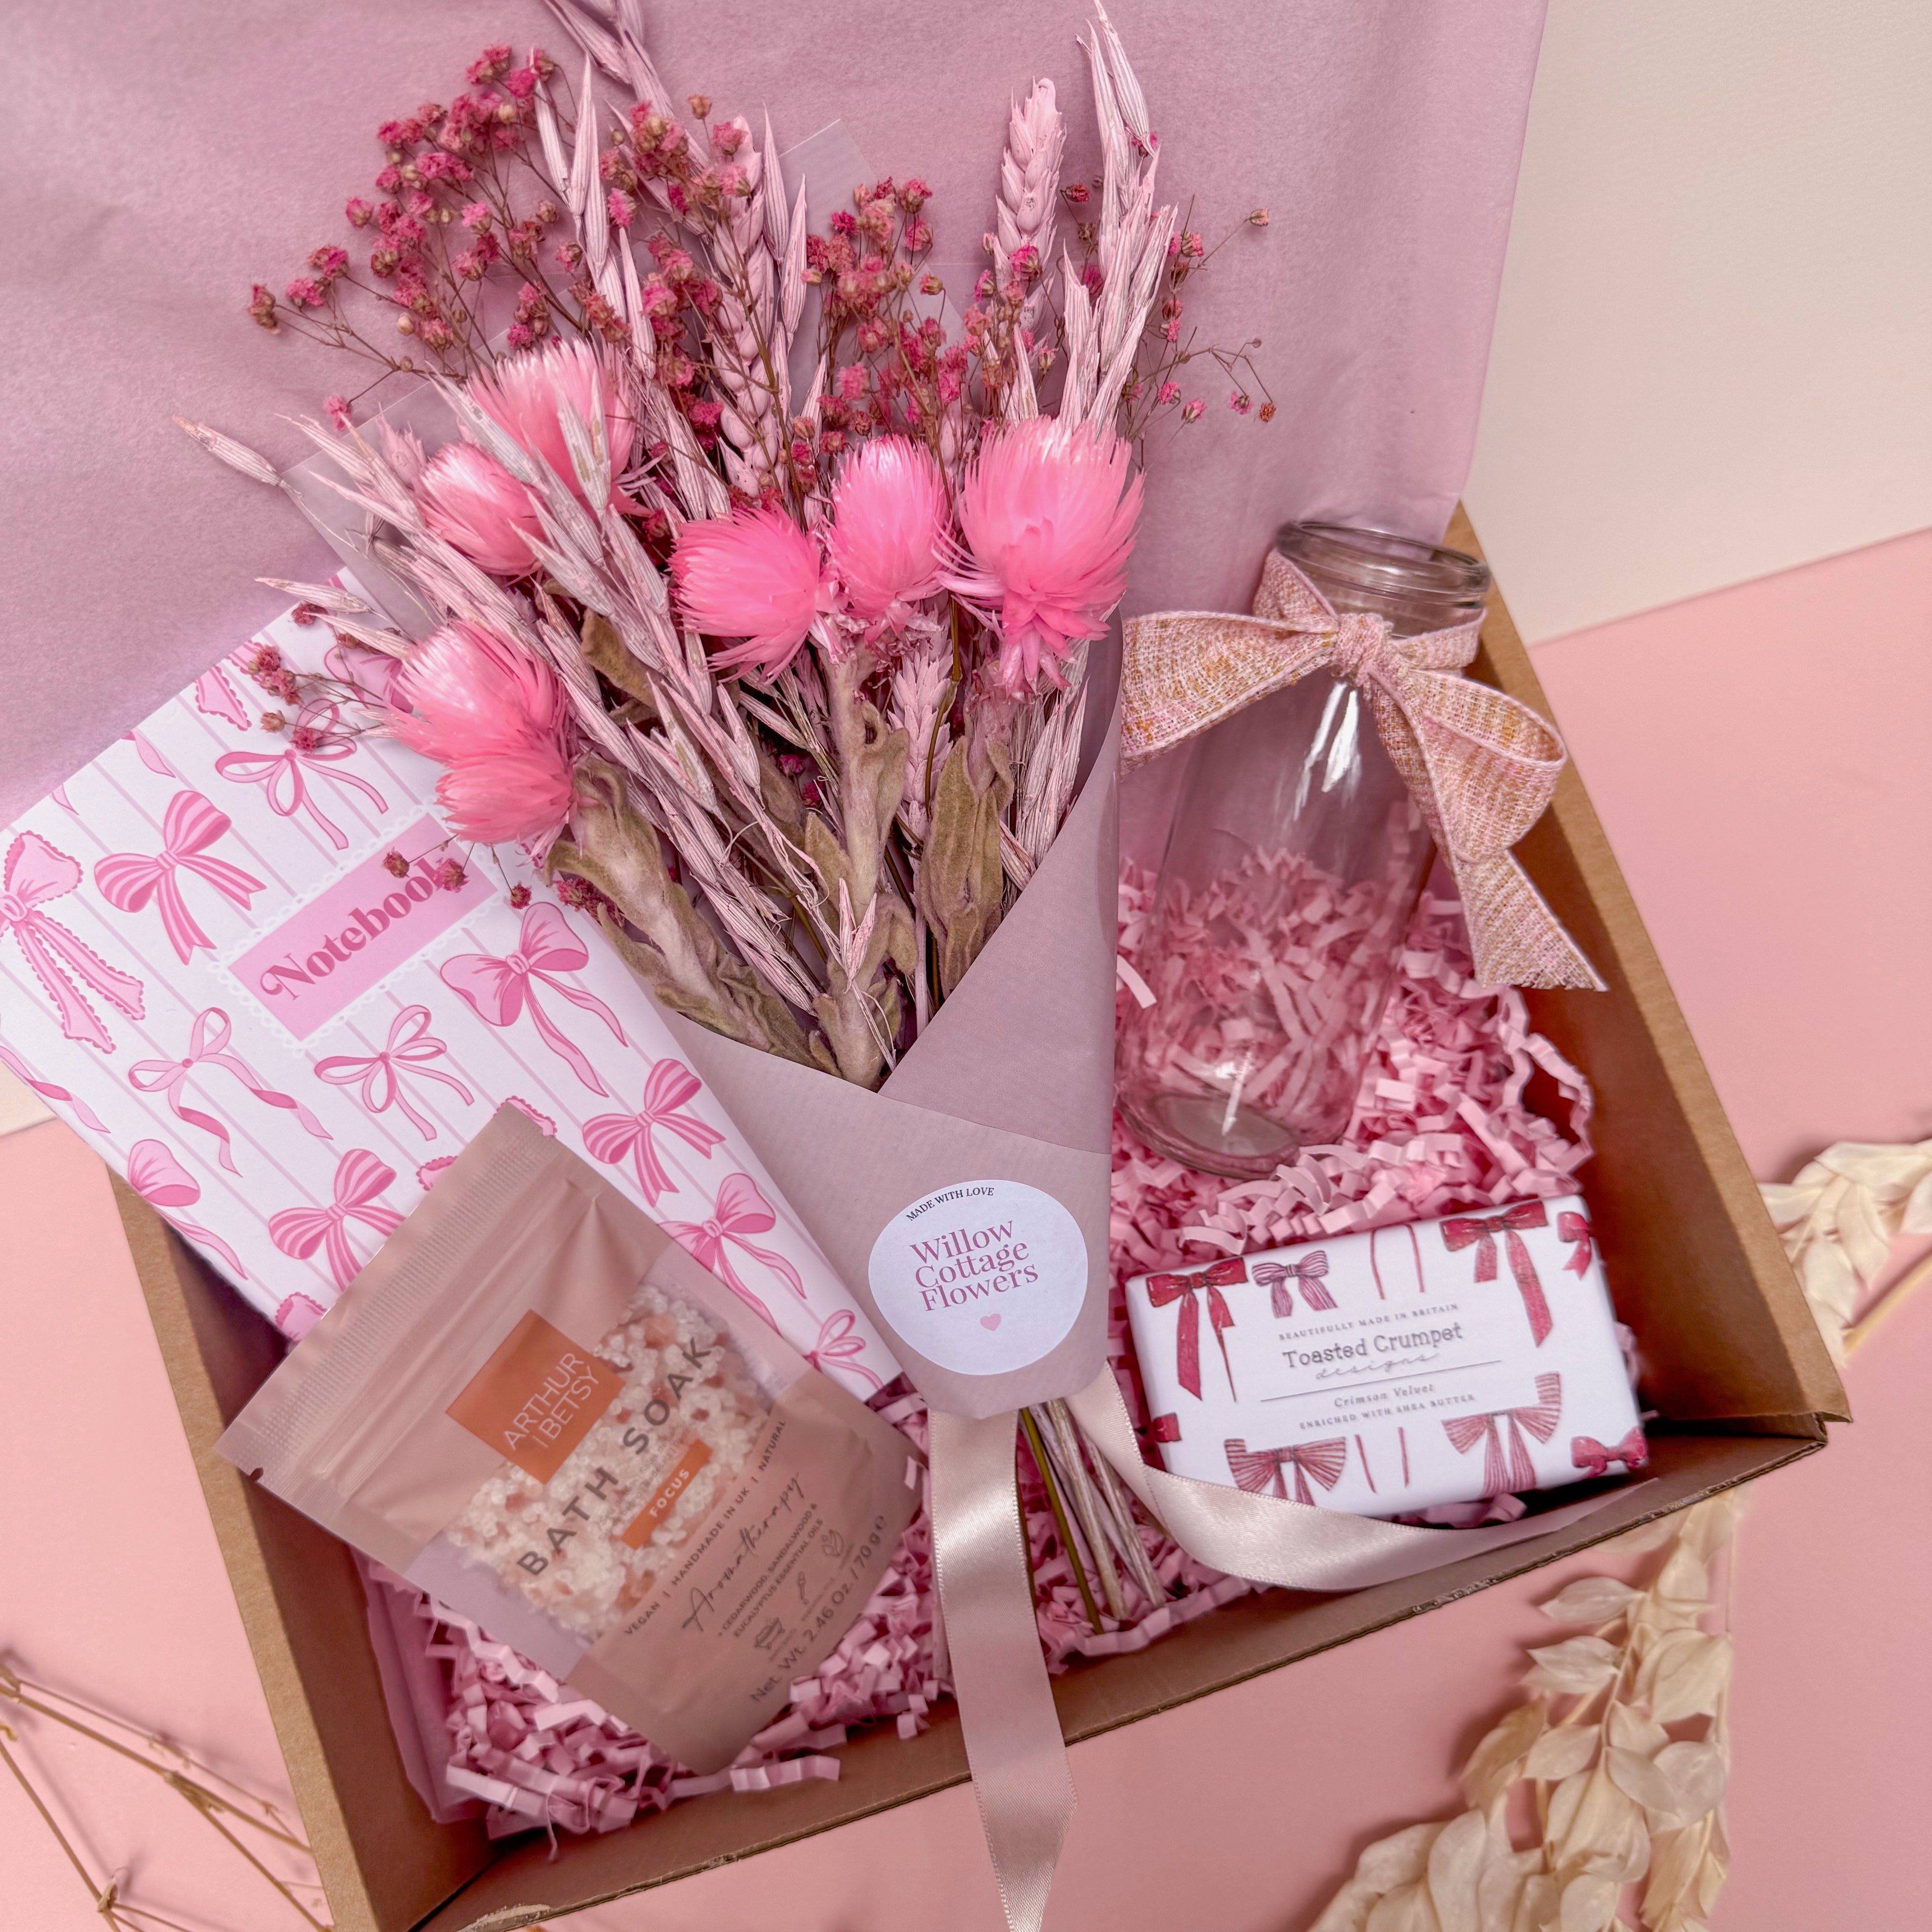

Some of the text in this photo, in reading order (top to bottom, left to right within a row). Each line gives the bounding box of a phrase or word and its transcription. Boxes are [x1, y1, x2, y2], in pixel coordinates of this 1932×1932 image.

[906, 1187, 994, 1221] MADE WITH LOVE
[910, 1220, 1013, 1264] Willow
[915, 1243, 1029, 1288] Cottage
[919, 1264, 1038, 1312] Flowers
[1278, 1304, 1459, 1340] BEAUTIFULLY MADE IN BRITAIN
[1282, 1322, 1463, 1368] Toasted Crumpet
[1316, 1353, 1440, 1380] designs
[504, 1352, 584, 1451] ARTHUR
[538, 1365, 599, 1439] BETSY
[1299, 1393, 1475, 1429] ENRICHED WITH SHEA BUTTER
[1334, 1384, 1434, 1407] Crimson Velvet
[517, 1337, 712, 1575] BATH SOAK
[649, 1469, 690, 1517] FOCUS
[623, 1601, 661, 1635] VEGAN
[672, 1521, 725, 1586] HANDMADE
[724, 1506, 736, 1519] IN
[735, 1487, 750, 1504] UK
[759, 1420, 786, 1471] NATURAL
[682, 1472, 804, 1632] Aromatherapy
[722, 1575, 770, 1630] CEDARWOOD,
[767, 1510, 813, 1573] SANDALWOOD
[734, 1585, 778, 1637] EUCALYPTUS
[775, 1541, 810, 1584] ESSENTIAL
[808, 1518, 823, 1539] OILS
[778, 1646, 806, 1669] Wt.
[803, 1606, 834, 1643] 2.46
[832, 1583, 854, 1604] Oz.
